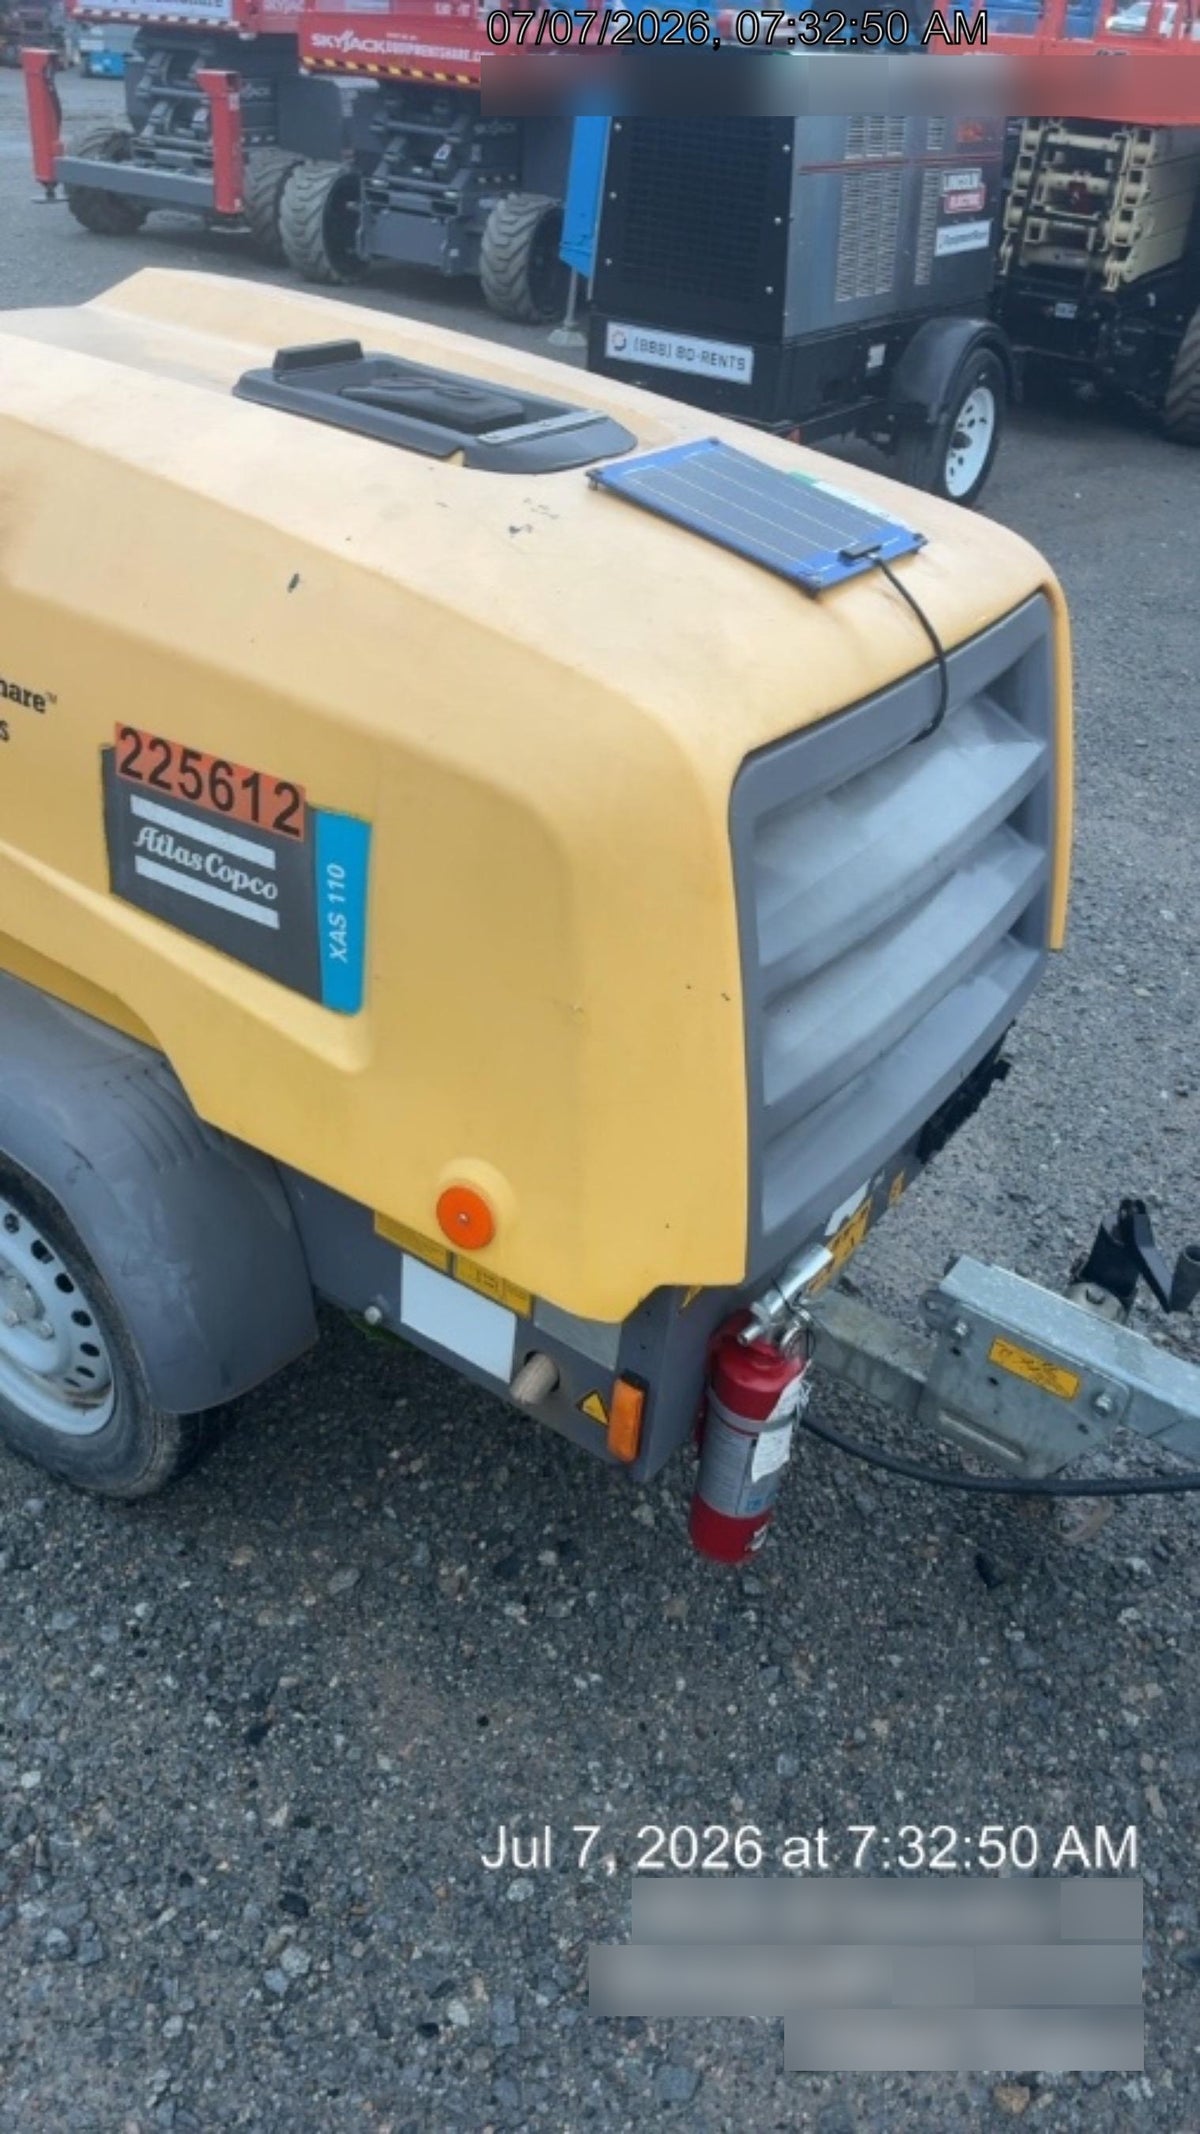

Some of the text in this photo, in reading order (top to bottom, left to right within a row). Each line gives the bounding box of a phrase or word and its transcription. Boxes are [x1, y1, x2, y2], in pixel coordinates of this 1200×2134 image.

[312, 30, 386, 54] SKYJACK
[119, 727, 301, 835] 225612
[134, 826, 278, 899] Atlas Copco
[327, 864, 347, 962] XAS 110
